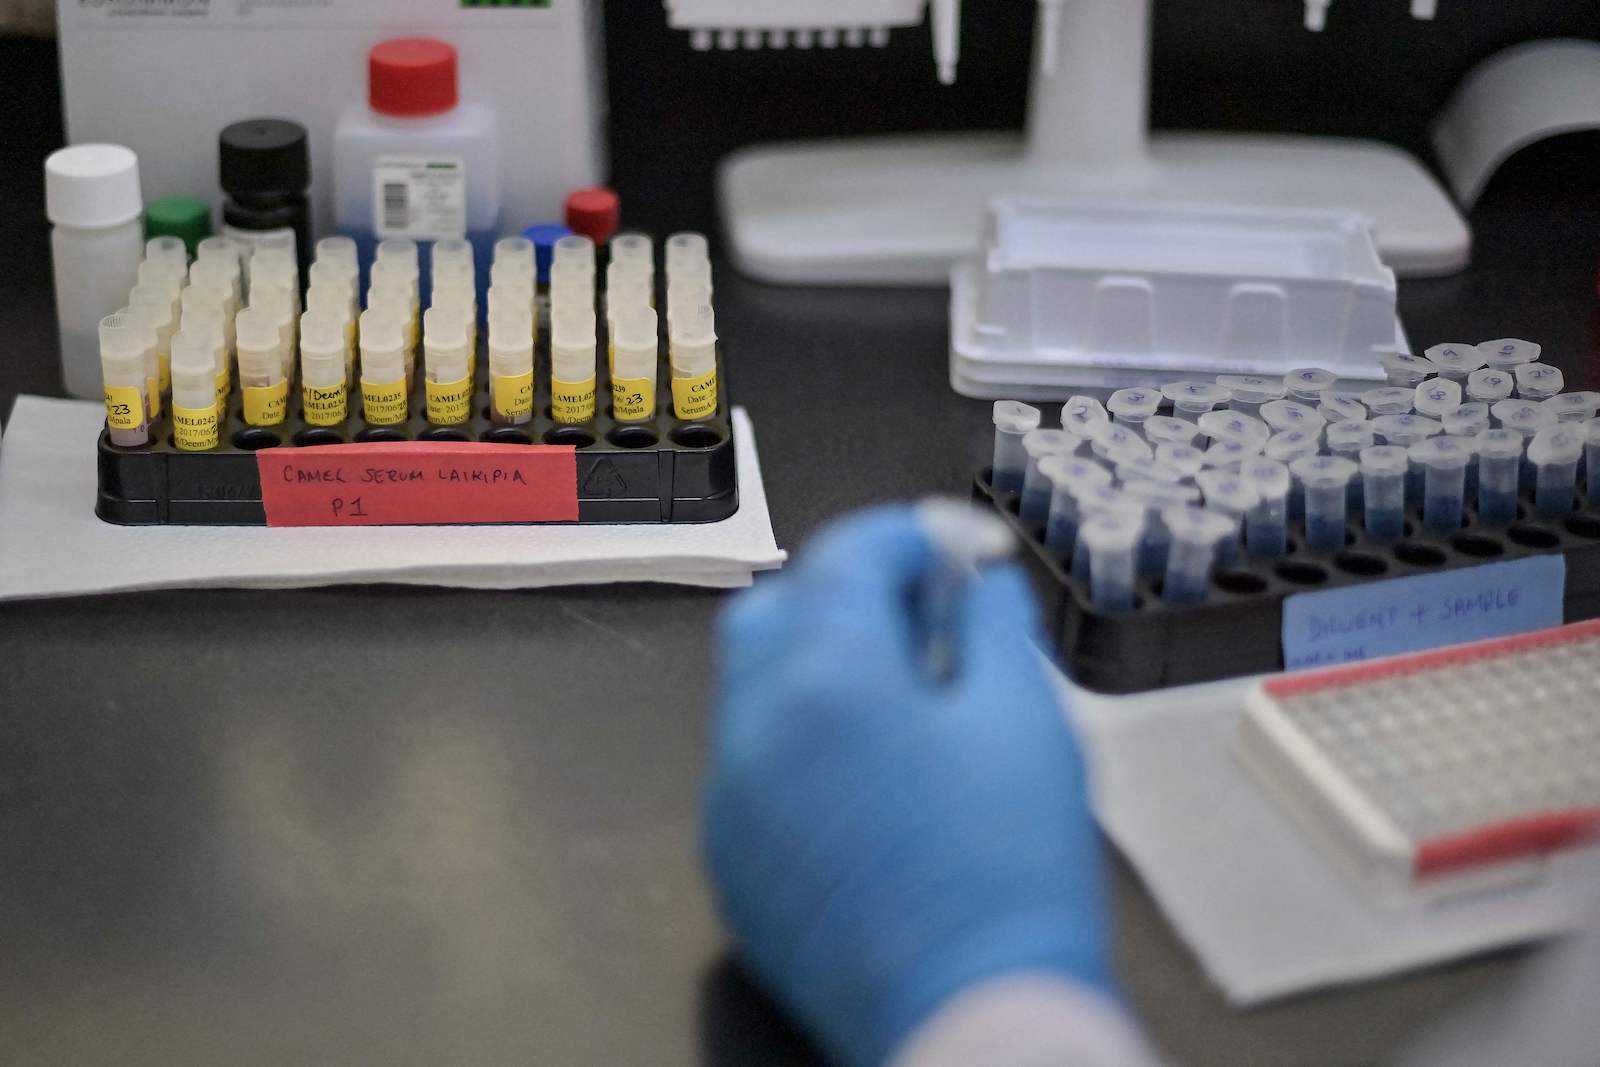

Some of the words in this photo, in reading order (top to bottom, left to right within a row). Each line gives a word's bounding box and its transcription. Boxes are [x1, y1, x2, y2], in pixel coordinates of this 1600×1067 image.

[625, 393, 644, 405] 23
[112, 404, 131, 416] 23
[283, 464, 348, 483] CAMEL
[361, 467, 424, 483] SERUM
[437, 467, 528, 486] LAIKIPIA
[331, 497, 369, 517] P1
